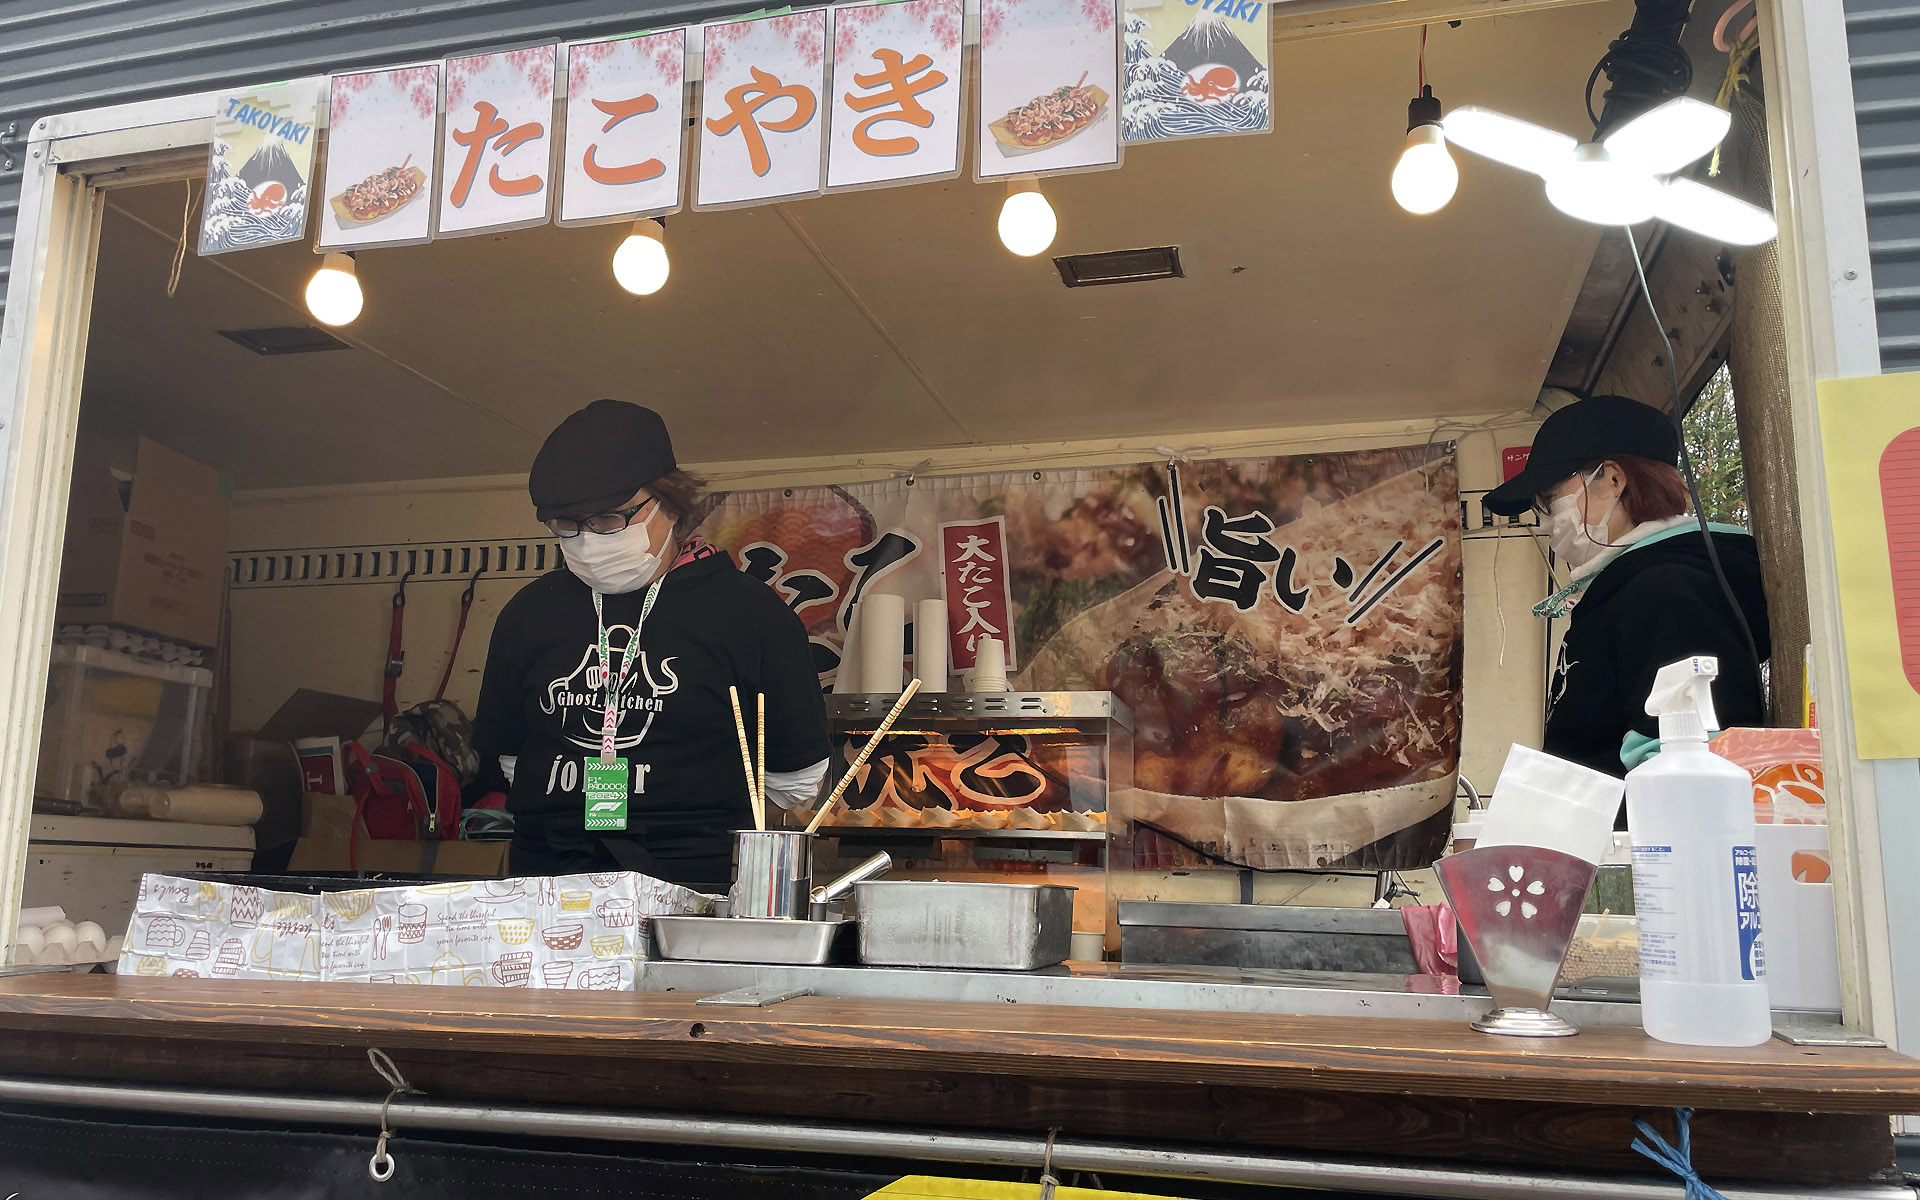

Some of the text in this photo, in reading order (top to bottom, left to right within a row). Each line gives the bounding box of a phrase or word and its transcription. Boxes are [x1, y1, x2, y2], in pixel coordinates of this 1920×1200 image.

[226, 97, 311, 145] TAKOYAKI
[1192, 508, 1354, 612] 旨い
[546, 754, 651, 795] jor
[153, 883, 190, 904] Bowls
[437, 908, 497, 925] Spend the blissful
[457, 924, 471, 932] time
[472, 921, 488, 930] with
[436, 938, 454, 949] your
[455, 934, 479, 947] favorite
